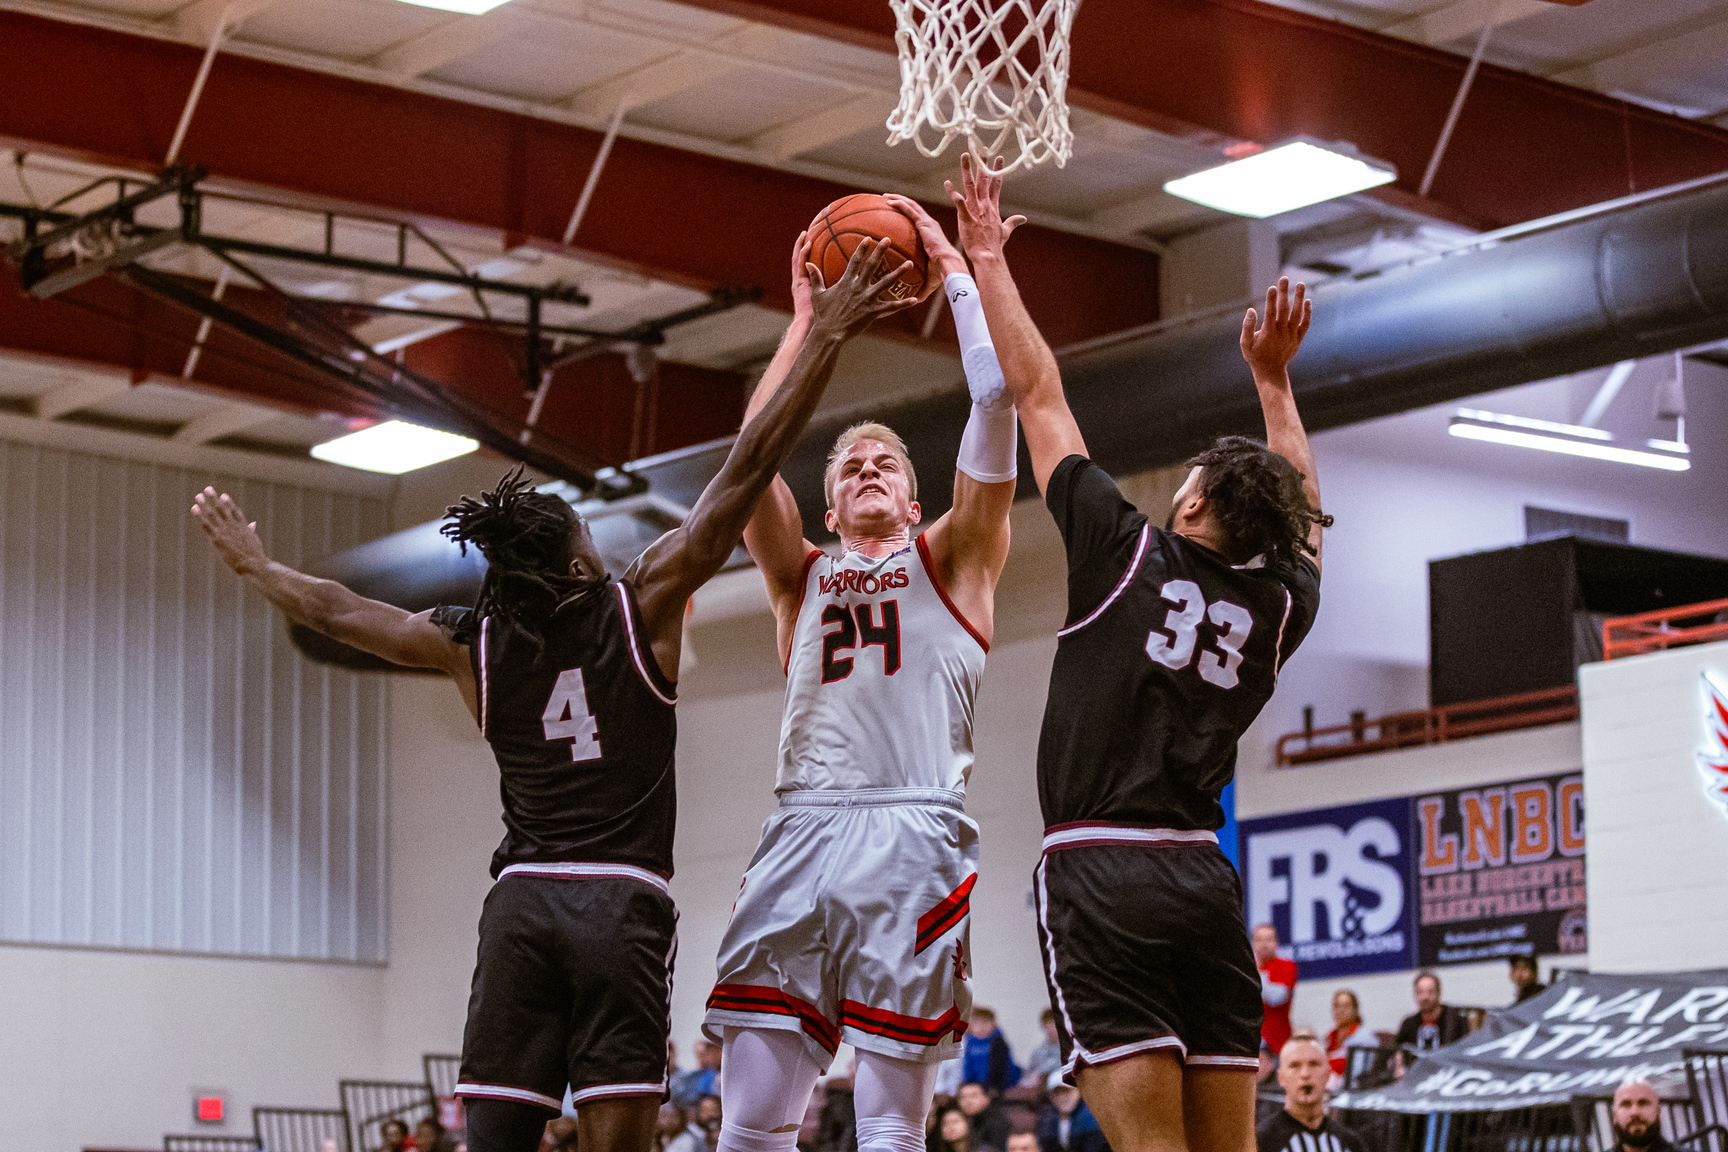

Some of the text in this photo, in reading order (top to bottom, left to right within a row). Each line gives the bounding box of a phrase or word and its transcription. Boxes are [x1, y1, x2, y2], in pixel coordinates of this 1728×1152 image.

[818, 567, 910, 597] WARRIORS
[821, 599, 901, 685] 24
[1145, 579, 1254, 690] 33
[541, 667, 602, 763] 4
[1417, 776, 1585, 876] LNBC
